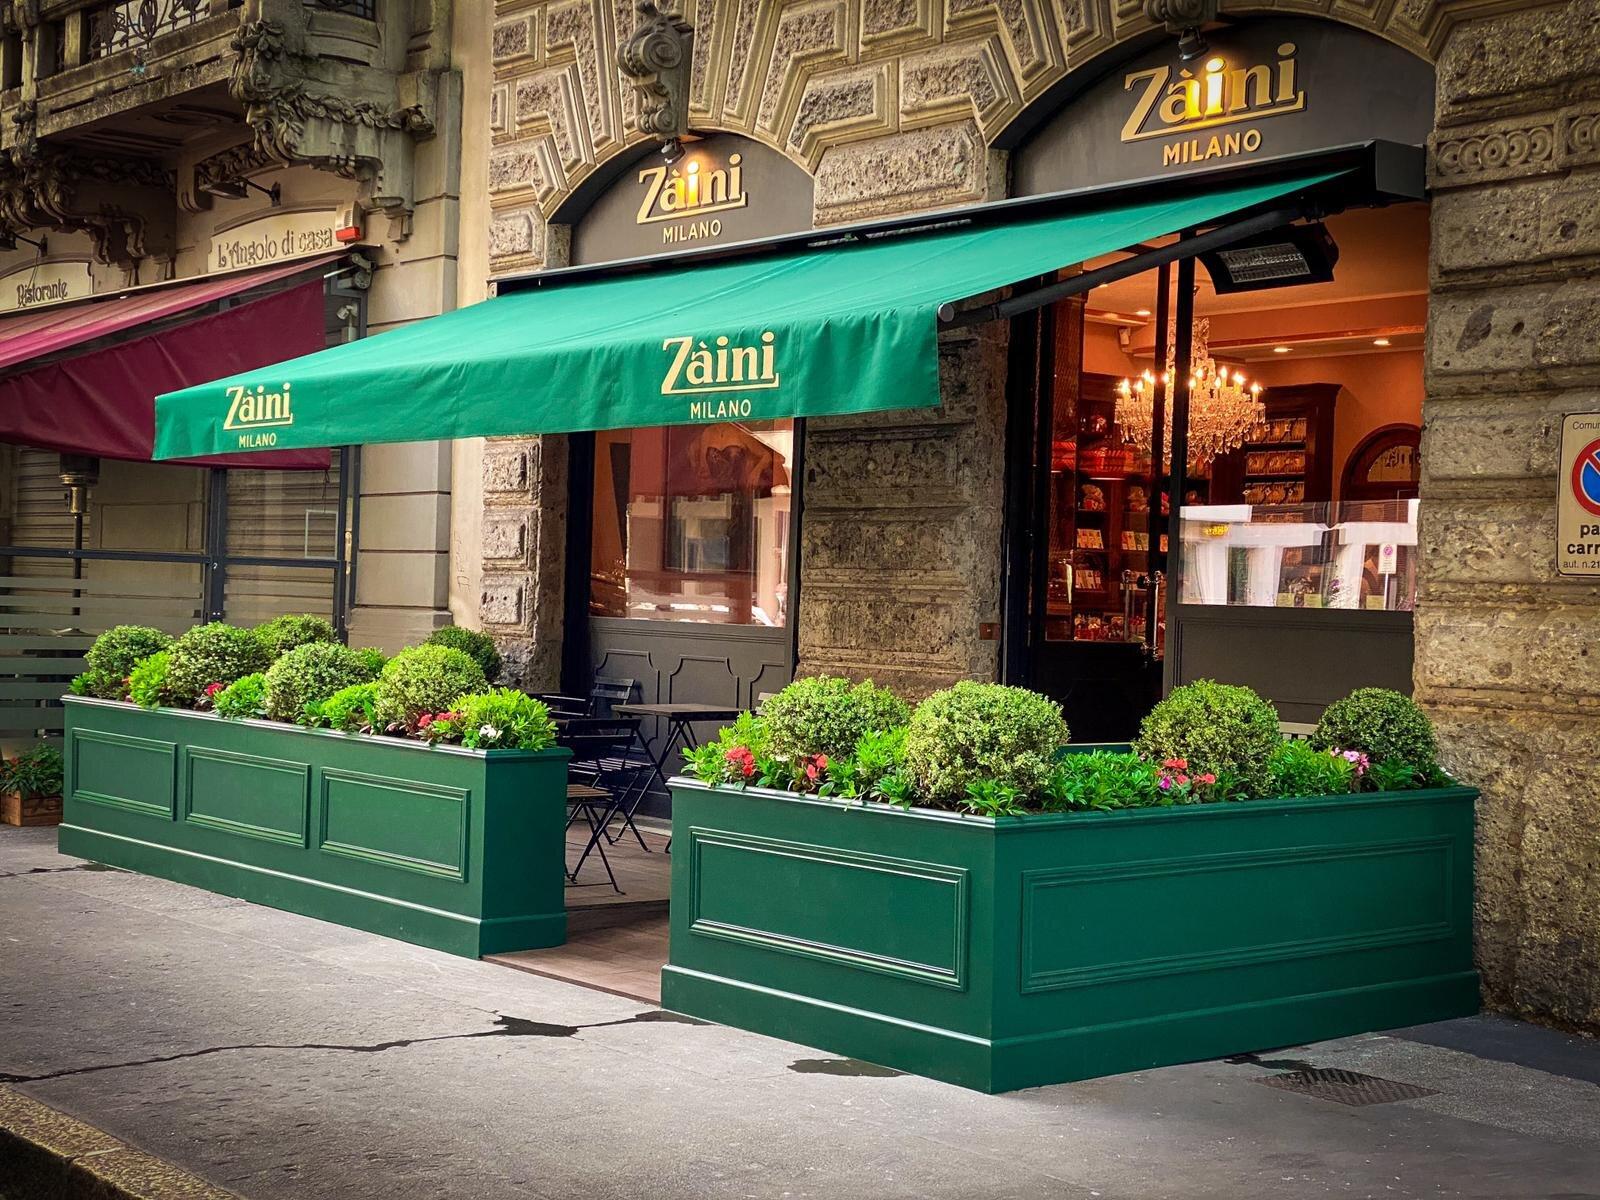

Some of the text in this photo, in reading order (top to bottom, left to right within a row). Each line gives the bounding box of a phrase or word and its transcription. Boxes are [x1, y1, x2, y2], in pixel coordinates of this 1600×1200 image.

[1121, 42, 1305, 143] Zàini
[1163, 128, 1262, 167] MILANO
[637, 153, 747, 225] Zàini
[217, 227, 333, 269] L'Angolo di casa
[663, 219, 722, 244] MILANO
[16, 278, 68, 309] Ristorante
[660, 331, 780, 395] Zàini
[223, 382, 294, 431] Zàini
[690, 398, 752, 419] MILANO
[238, 432, 277, 449] MILANO
[1566, 543, 1600, 555] carr
